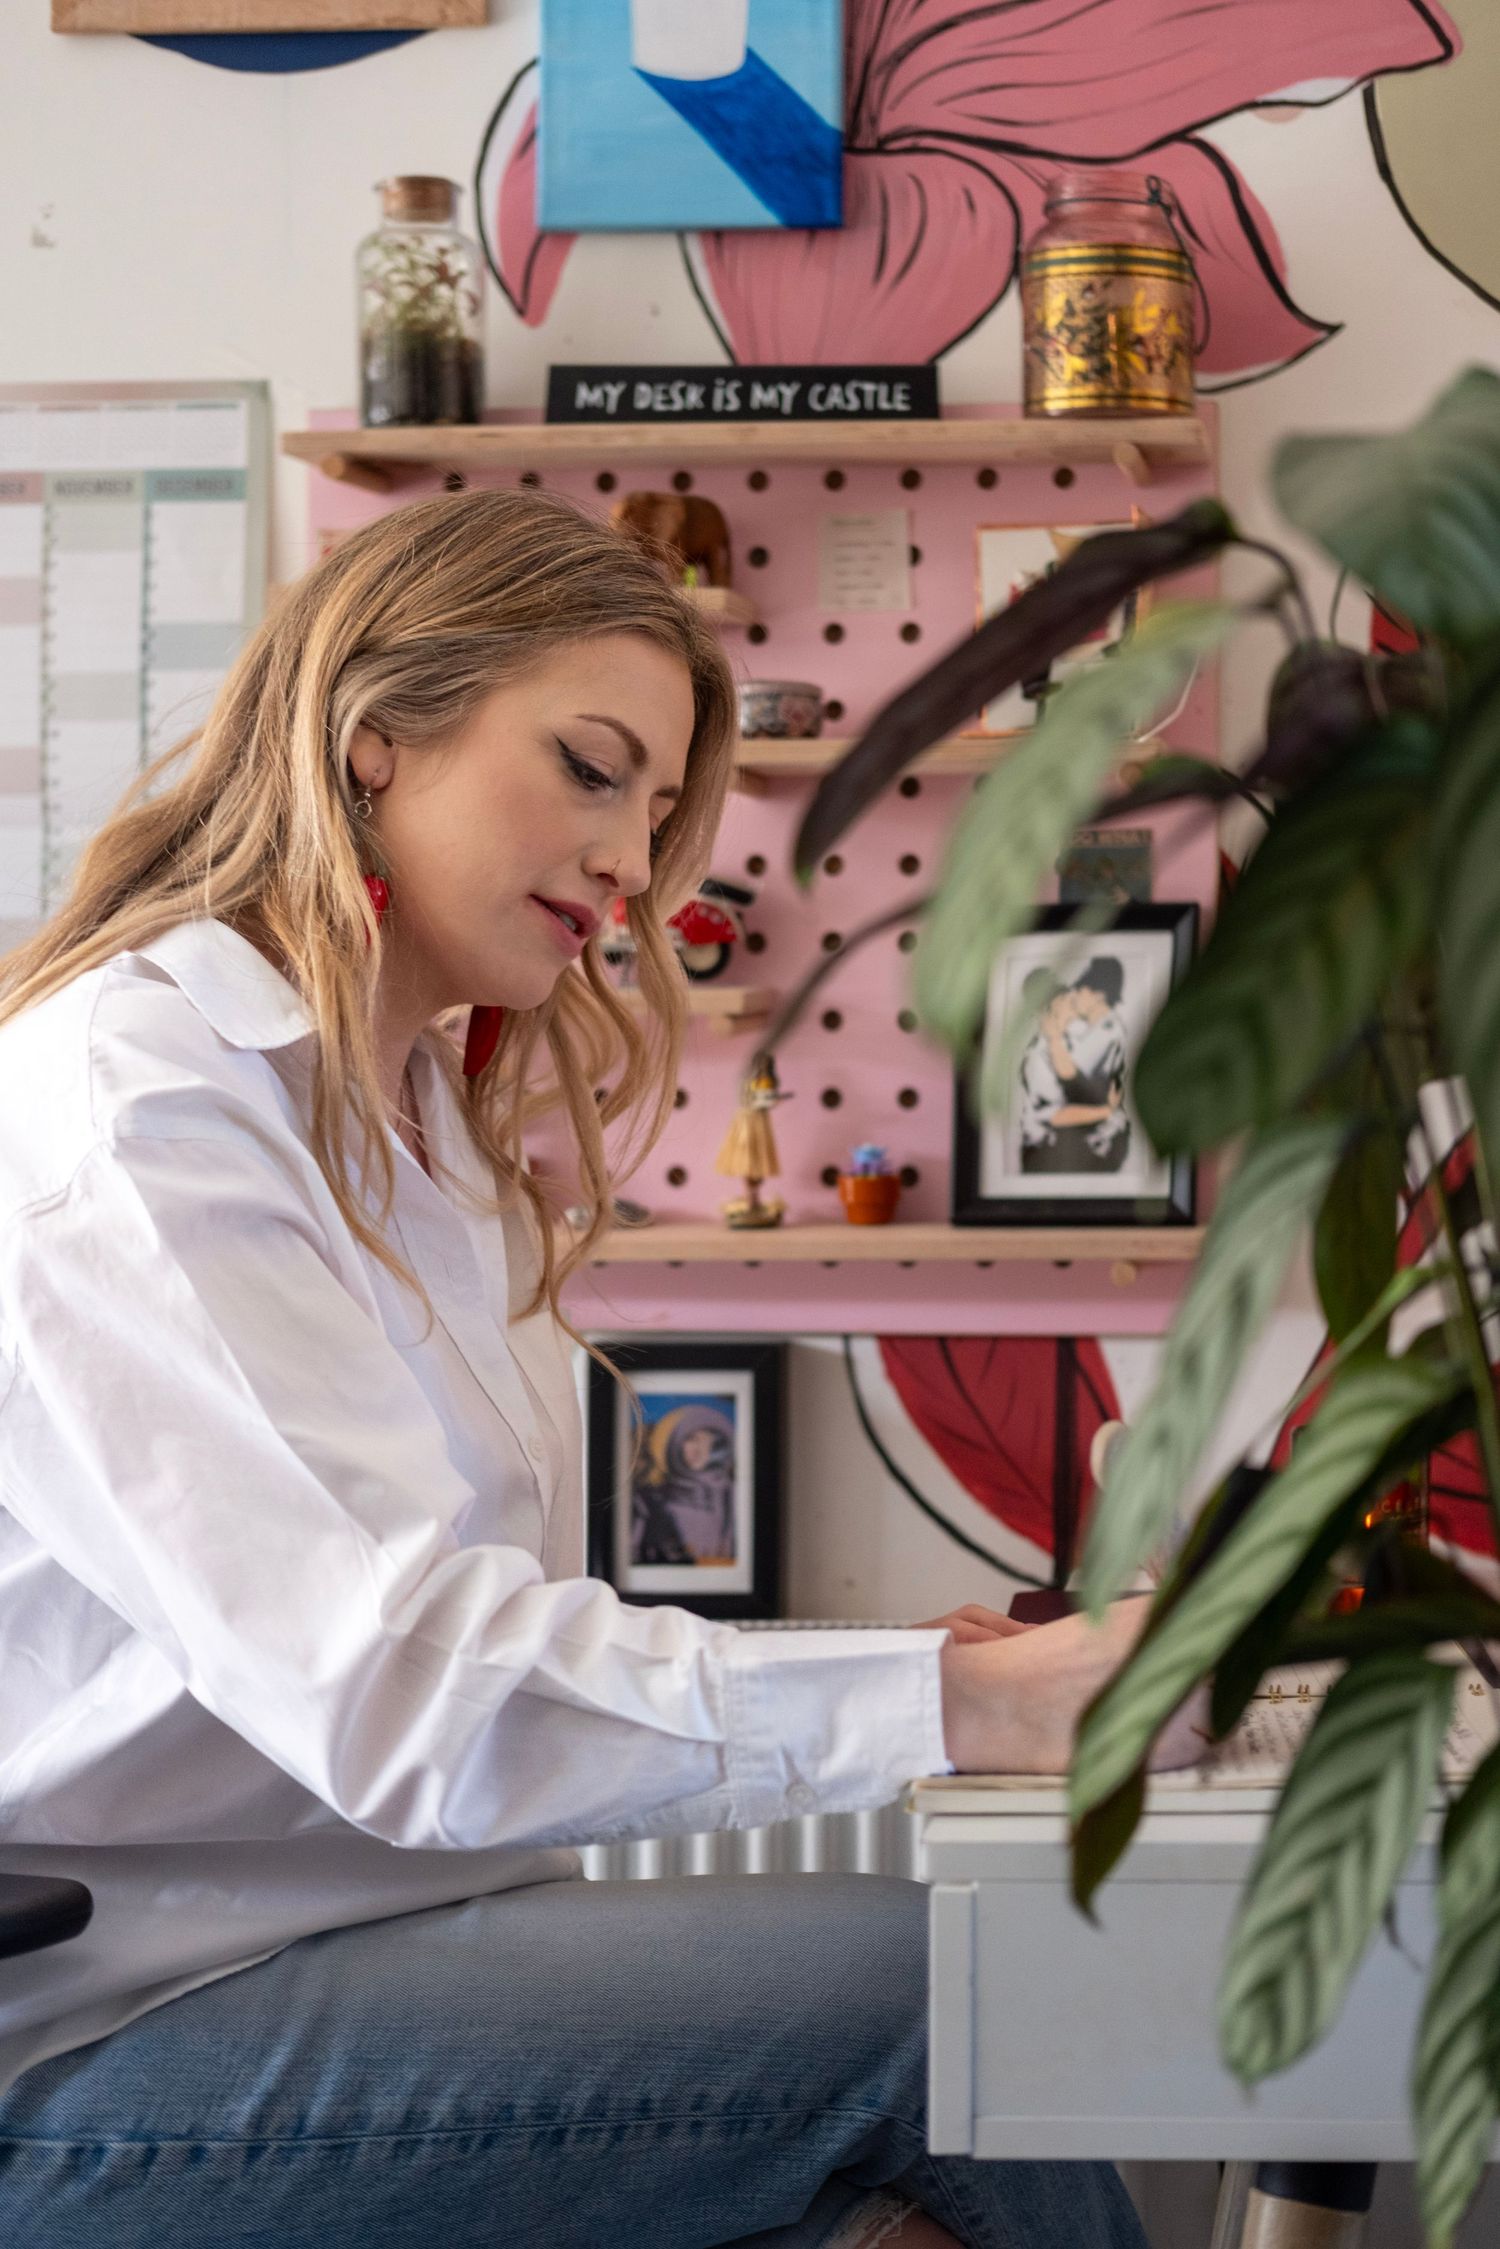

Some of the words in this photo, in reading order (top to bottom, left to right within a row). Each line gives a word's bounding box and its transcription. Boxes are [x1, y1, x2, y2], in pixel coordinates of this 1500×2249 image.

[575, 381, 627, 414] MY
[633, 380, 705, 411] DESK
[750, 381, 801, 414] MY
[808, 380, 912, 411] CASTLE
[54, 478, 134, 496] NOVEMBER
